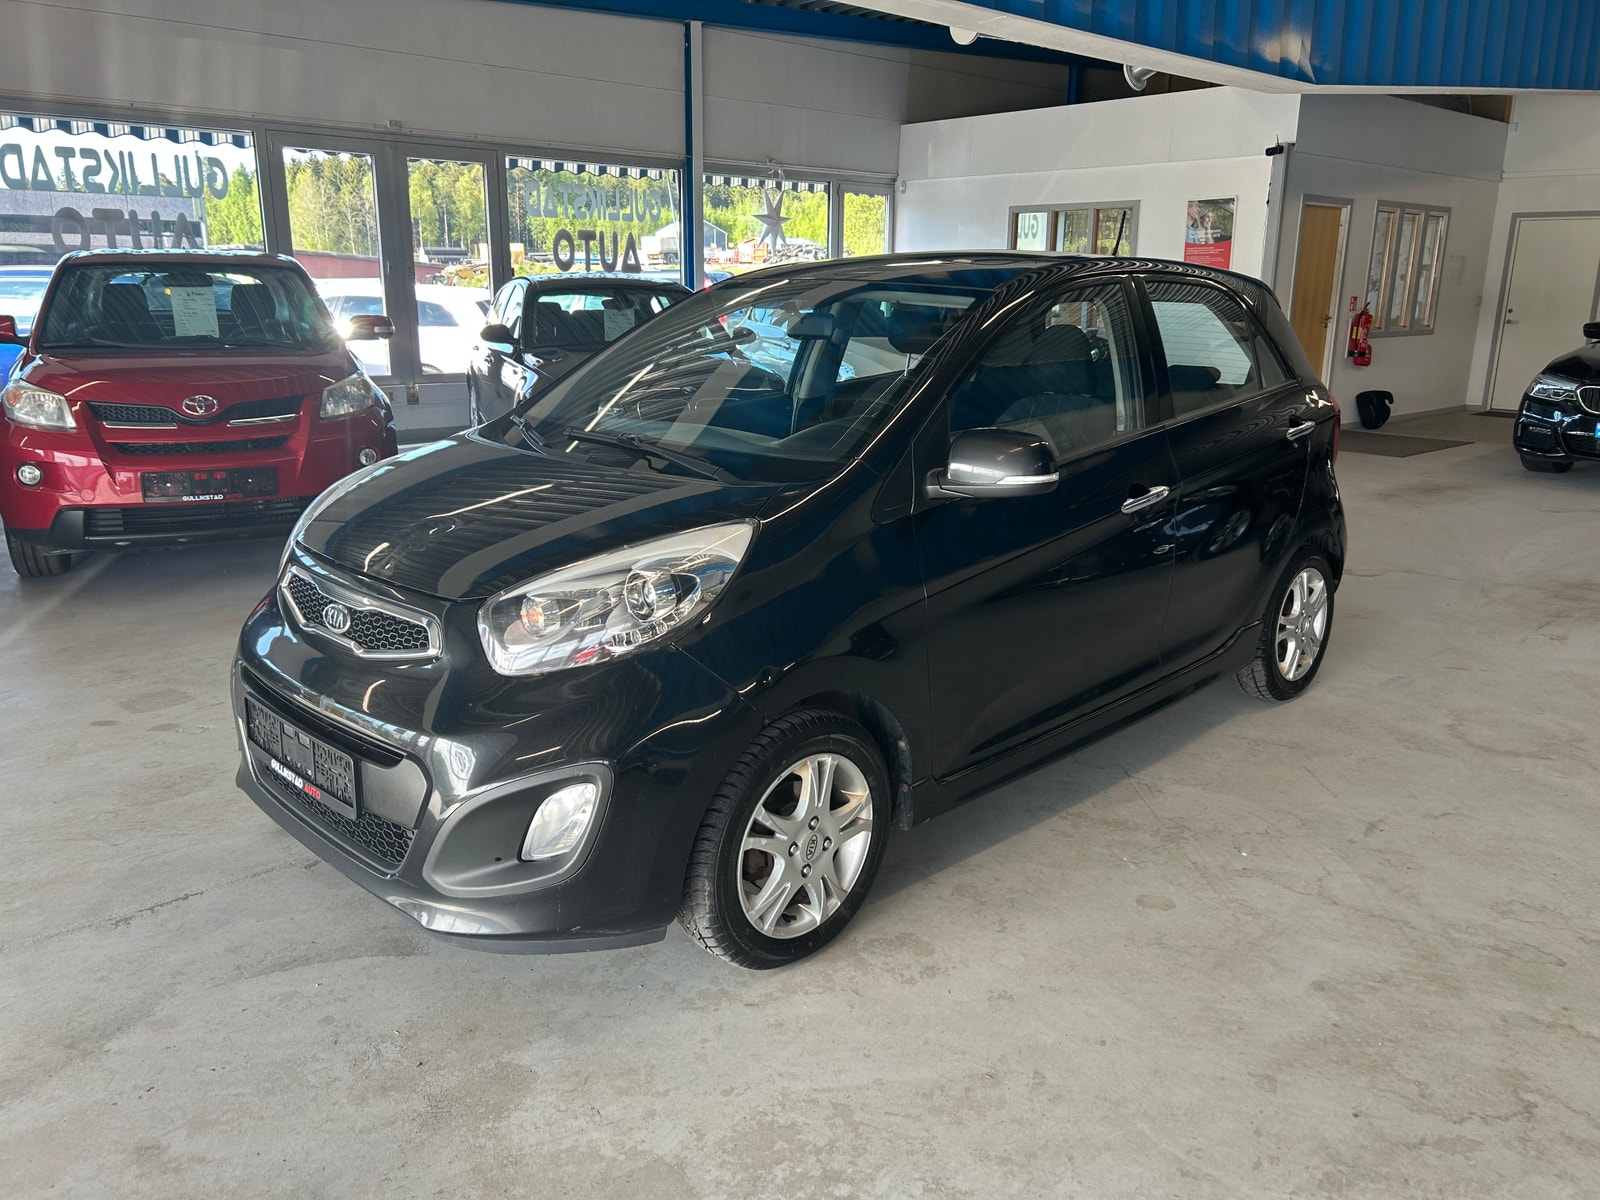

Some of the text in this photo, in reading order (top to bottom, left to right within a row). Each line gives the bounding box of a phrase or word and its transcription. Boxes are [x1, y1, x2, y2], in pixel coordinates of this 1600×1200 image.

[182, 494, 224, 502] GULLIKSTAD
[327, 606, 345, 629] KIA
[270, 758, 321, 800] GULLIKSTAD AUTO
[806, 837, 817, 857] KIA
